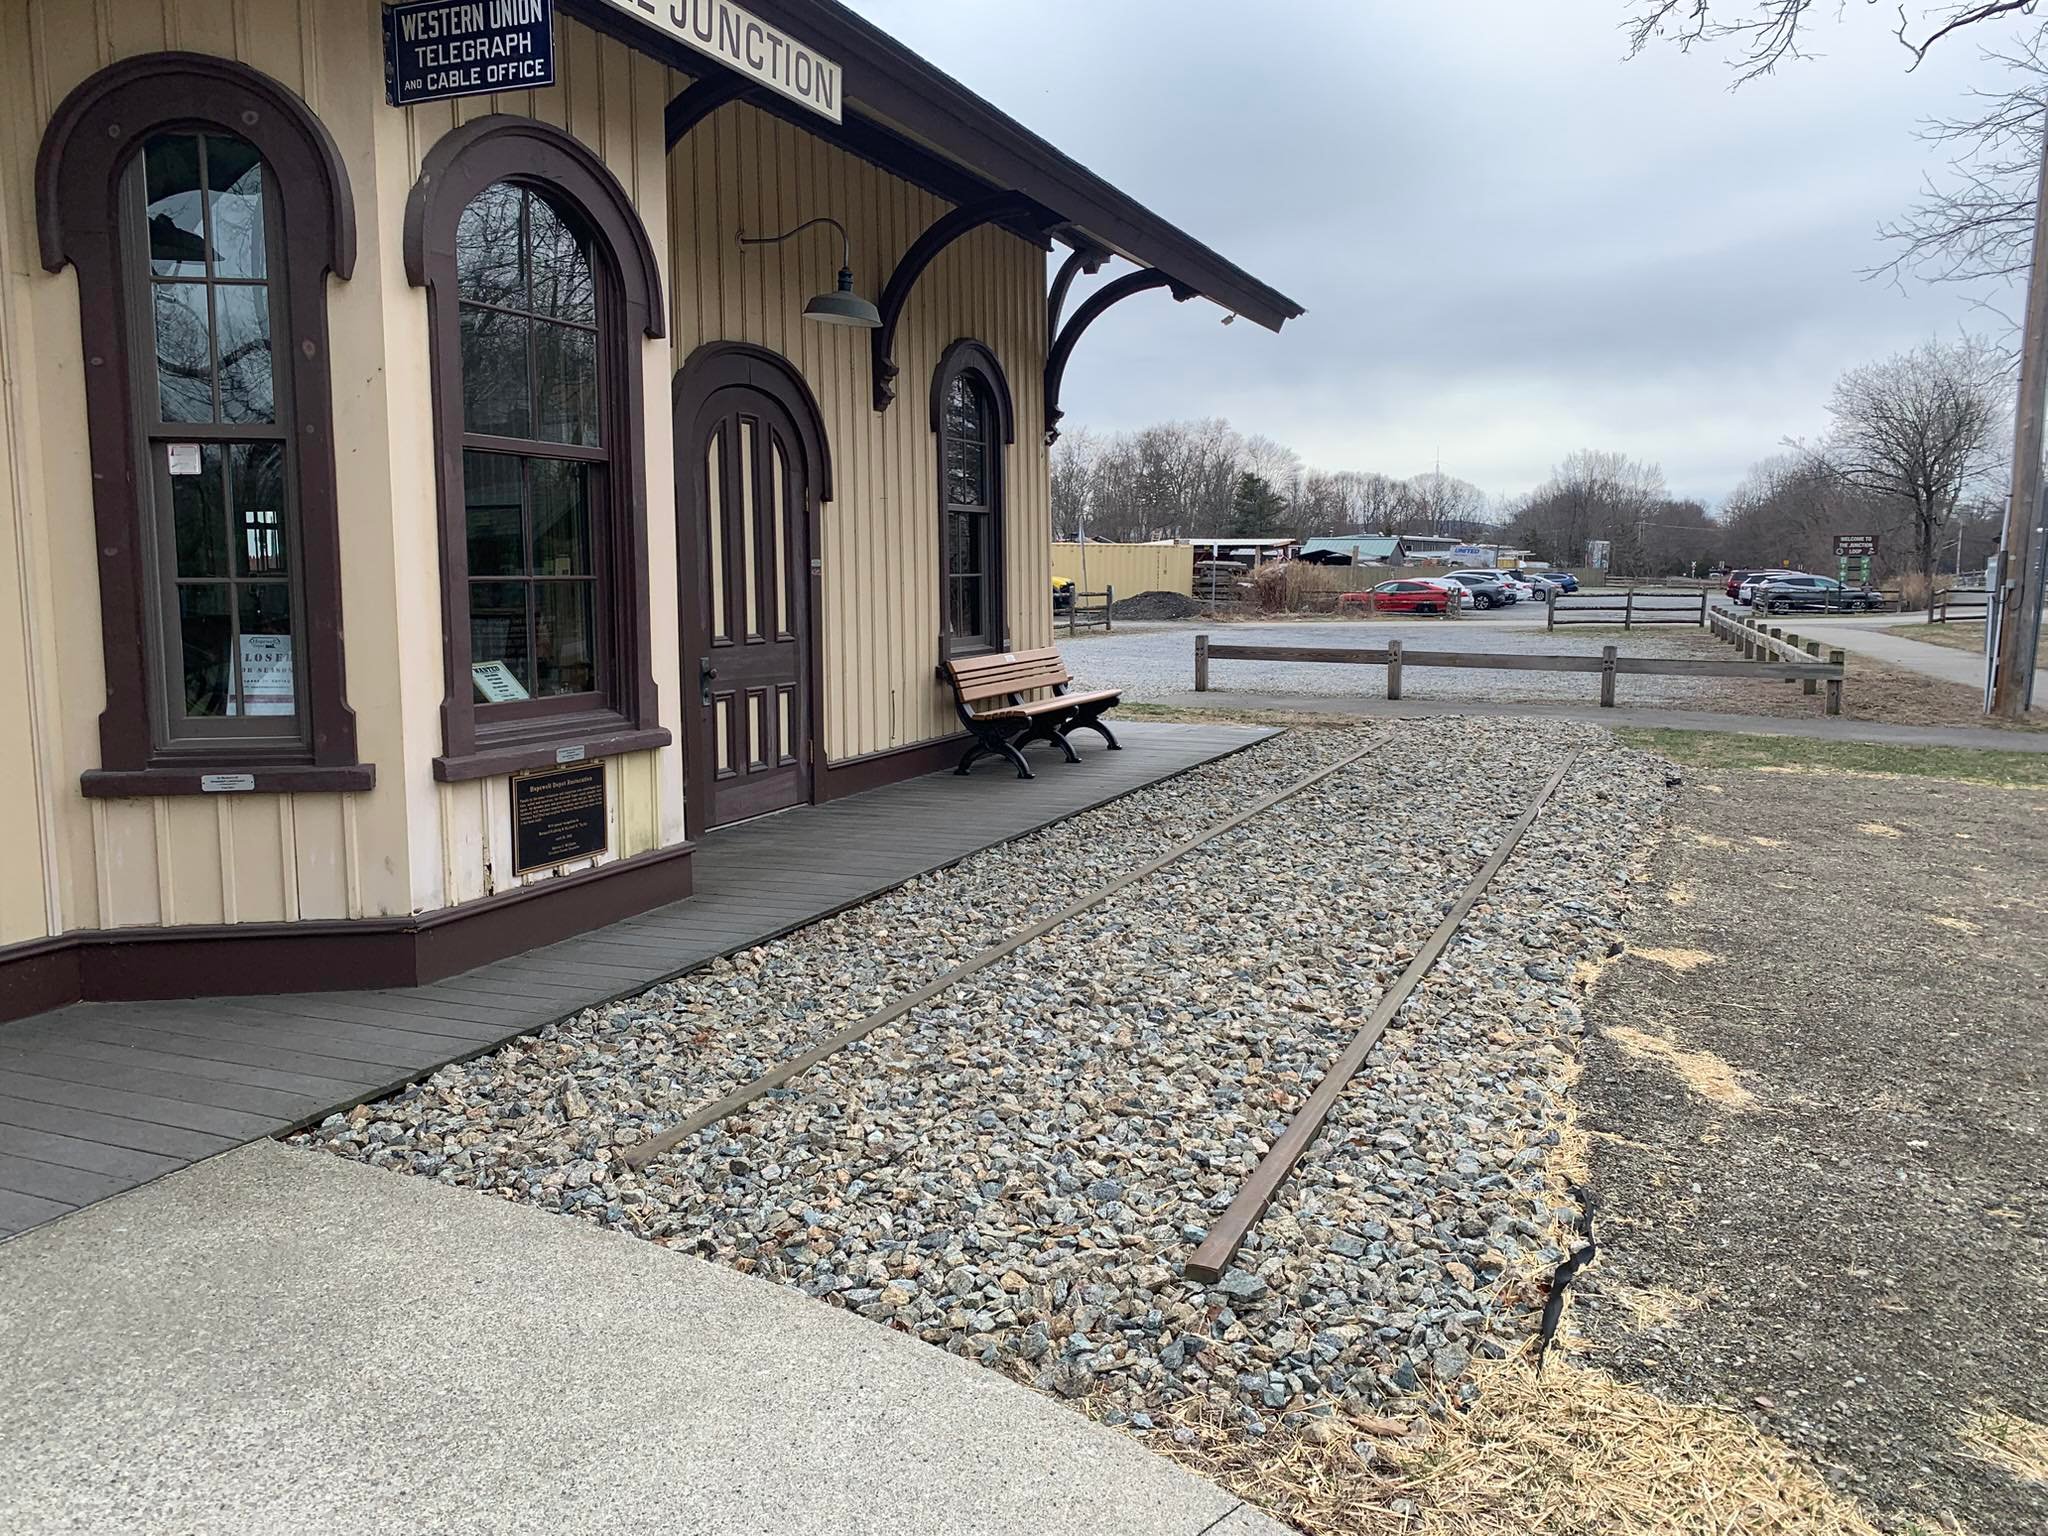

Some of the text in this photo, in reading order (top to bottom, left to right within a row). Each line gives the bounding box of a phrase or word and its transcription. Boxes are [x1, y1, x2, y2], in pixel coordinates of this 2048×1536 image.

[401, 0, 543, 42] WESTERN UNION
[414, 31, 532, 68] TELEGRAPH
[404, 59, 545, 91] AND CABLE OFFICE
